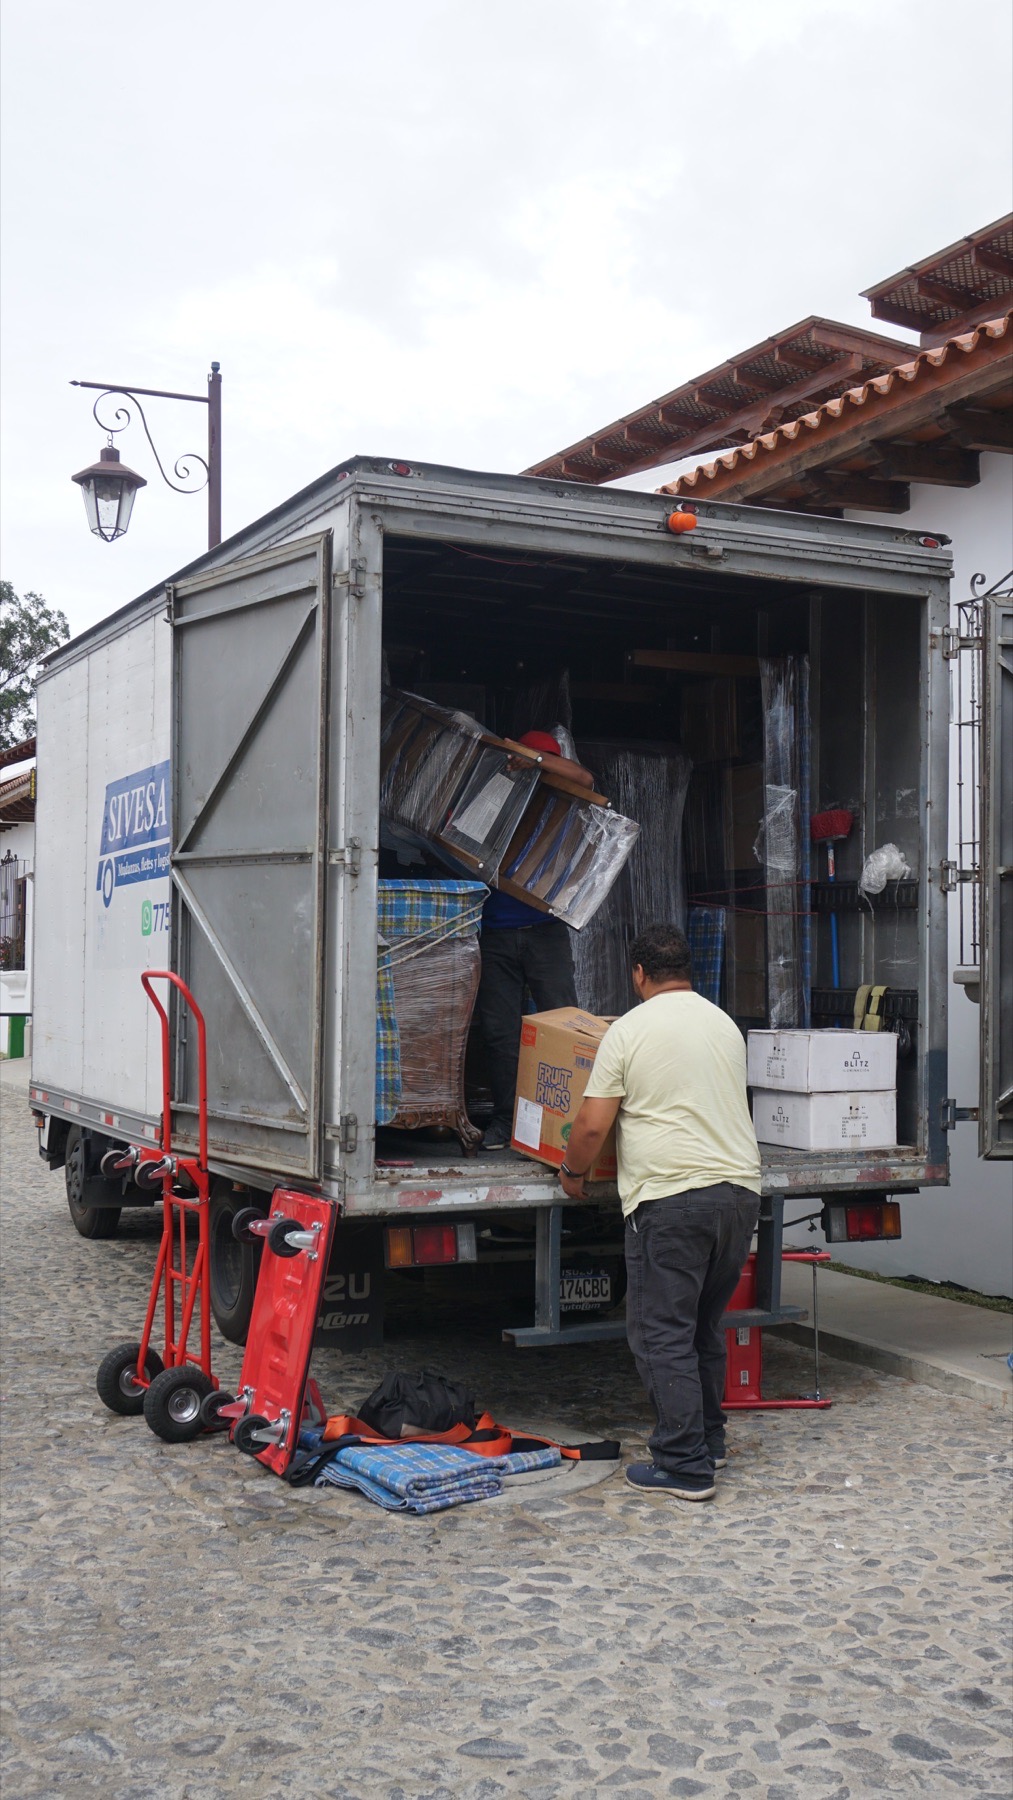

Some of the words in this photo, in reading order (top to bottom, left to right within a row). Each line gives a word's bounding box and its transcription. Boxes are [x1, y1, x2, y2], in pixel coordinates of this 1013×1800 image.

[108, 778, 167, 842] SIVESA
[538, 1062, 572, 1089] FRUIT
[844, 1060, 869, 1068] BLITZ
[536, 1082, 570, 1113] RINGS
